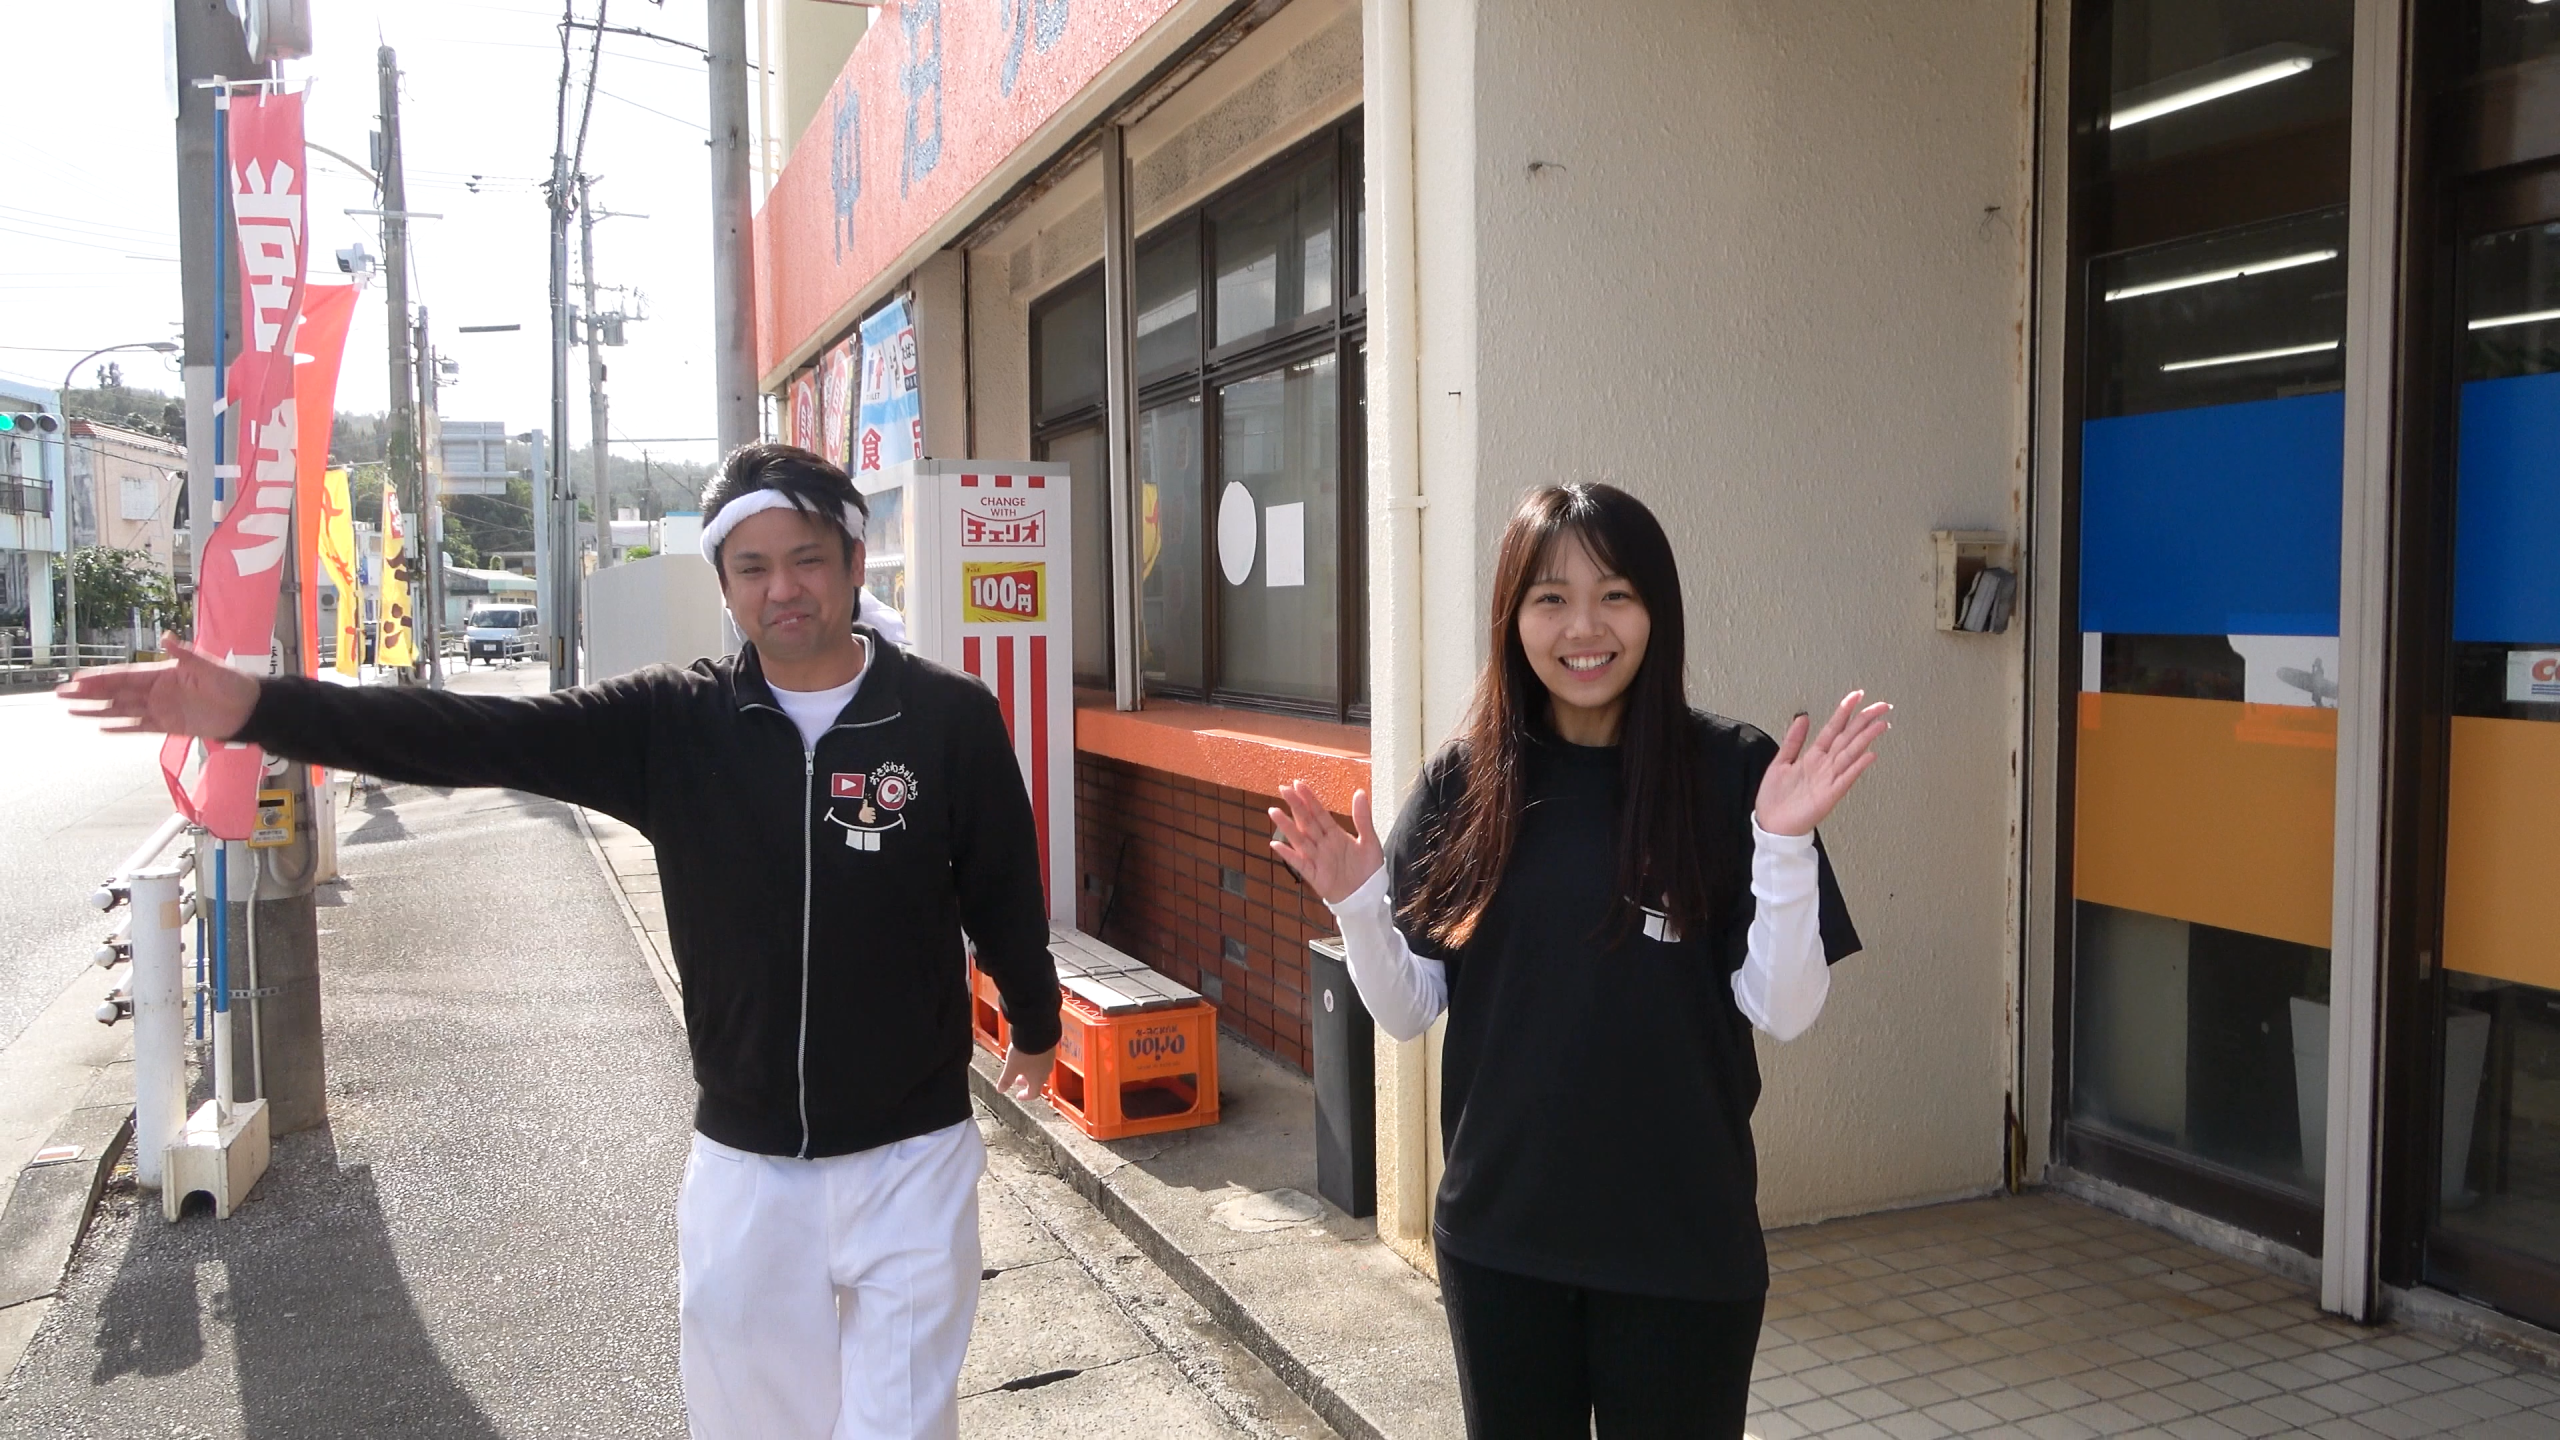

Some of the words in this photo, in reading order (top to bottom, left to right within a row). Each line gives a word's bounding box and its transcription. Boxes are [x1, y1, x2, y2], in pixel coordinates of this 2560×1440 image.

[980, 497, 1026, 507] CHANGE
[990, 508, 1017, 517] WITH
[967, 517, 1040, 543] チェリオ
